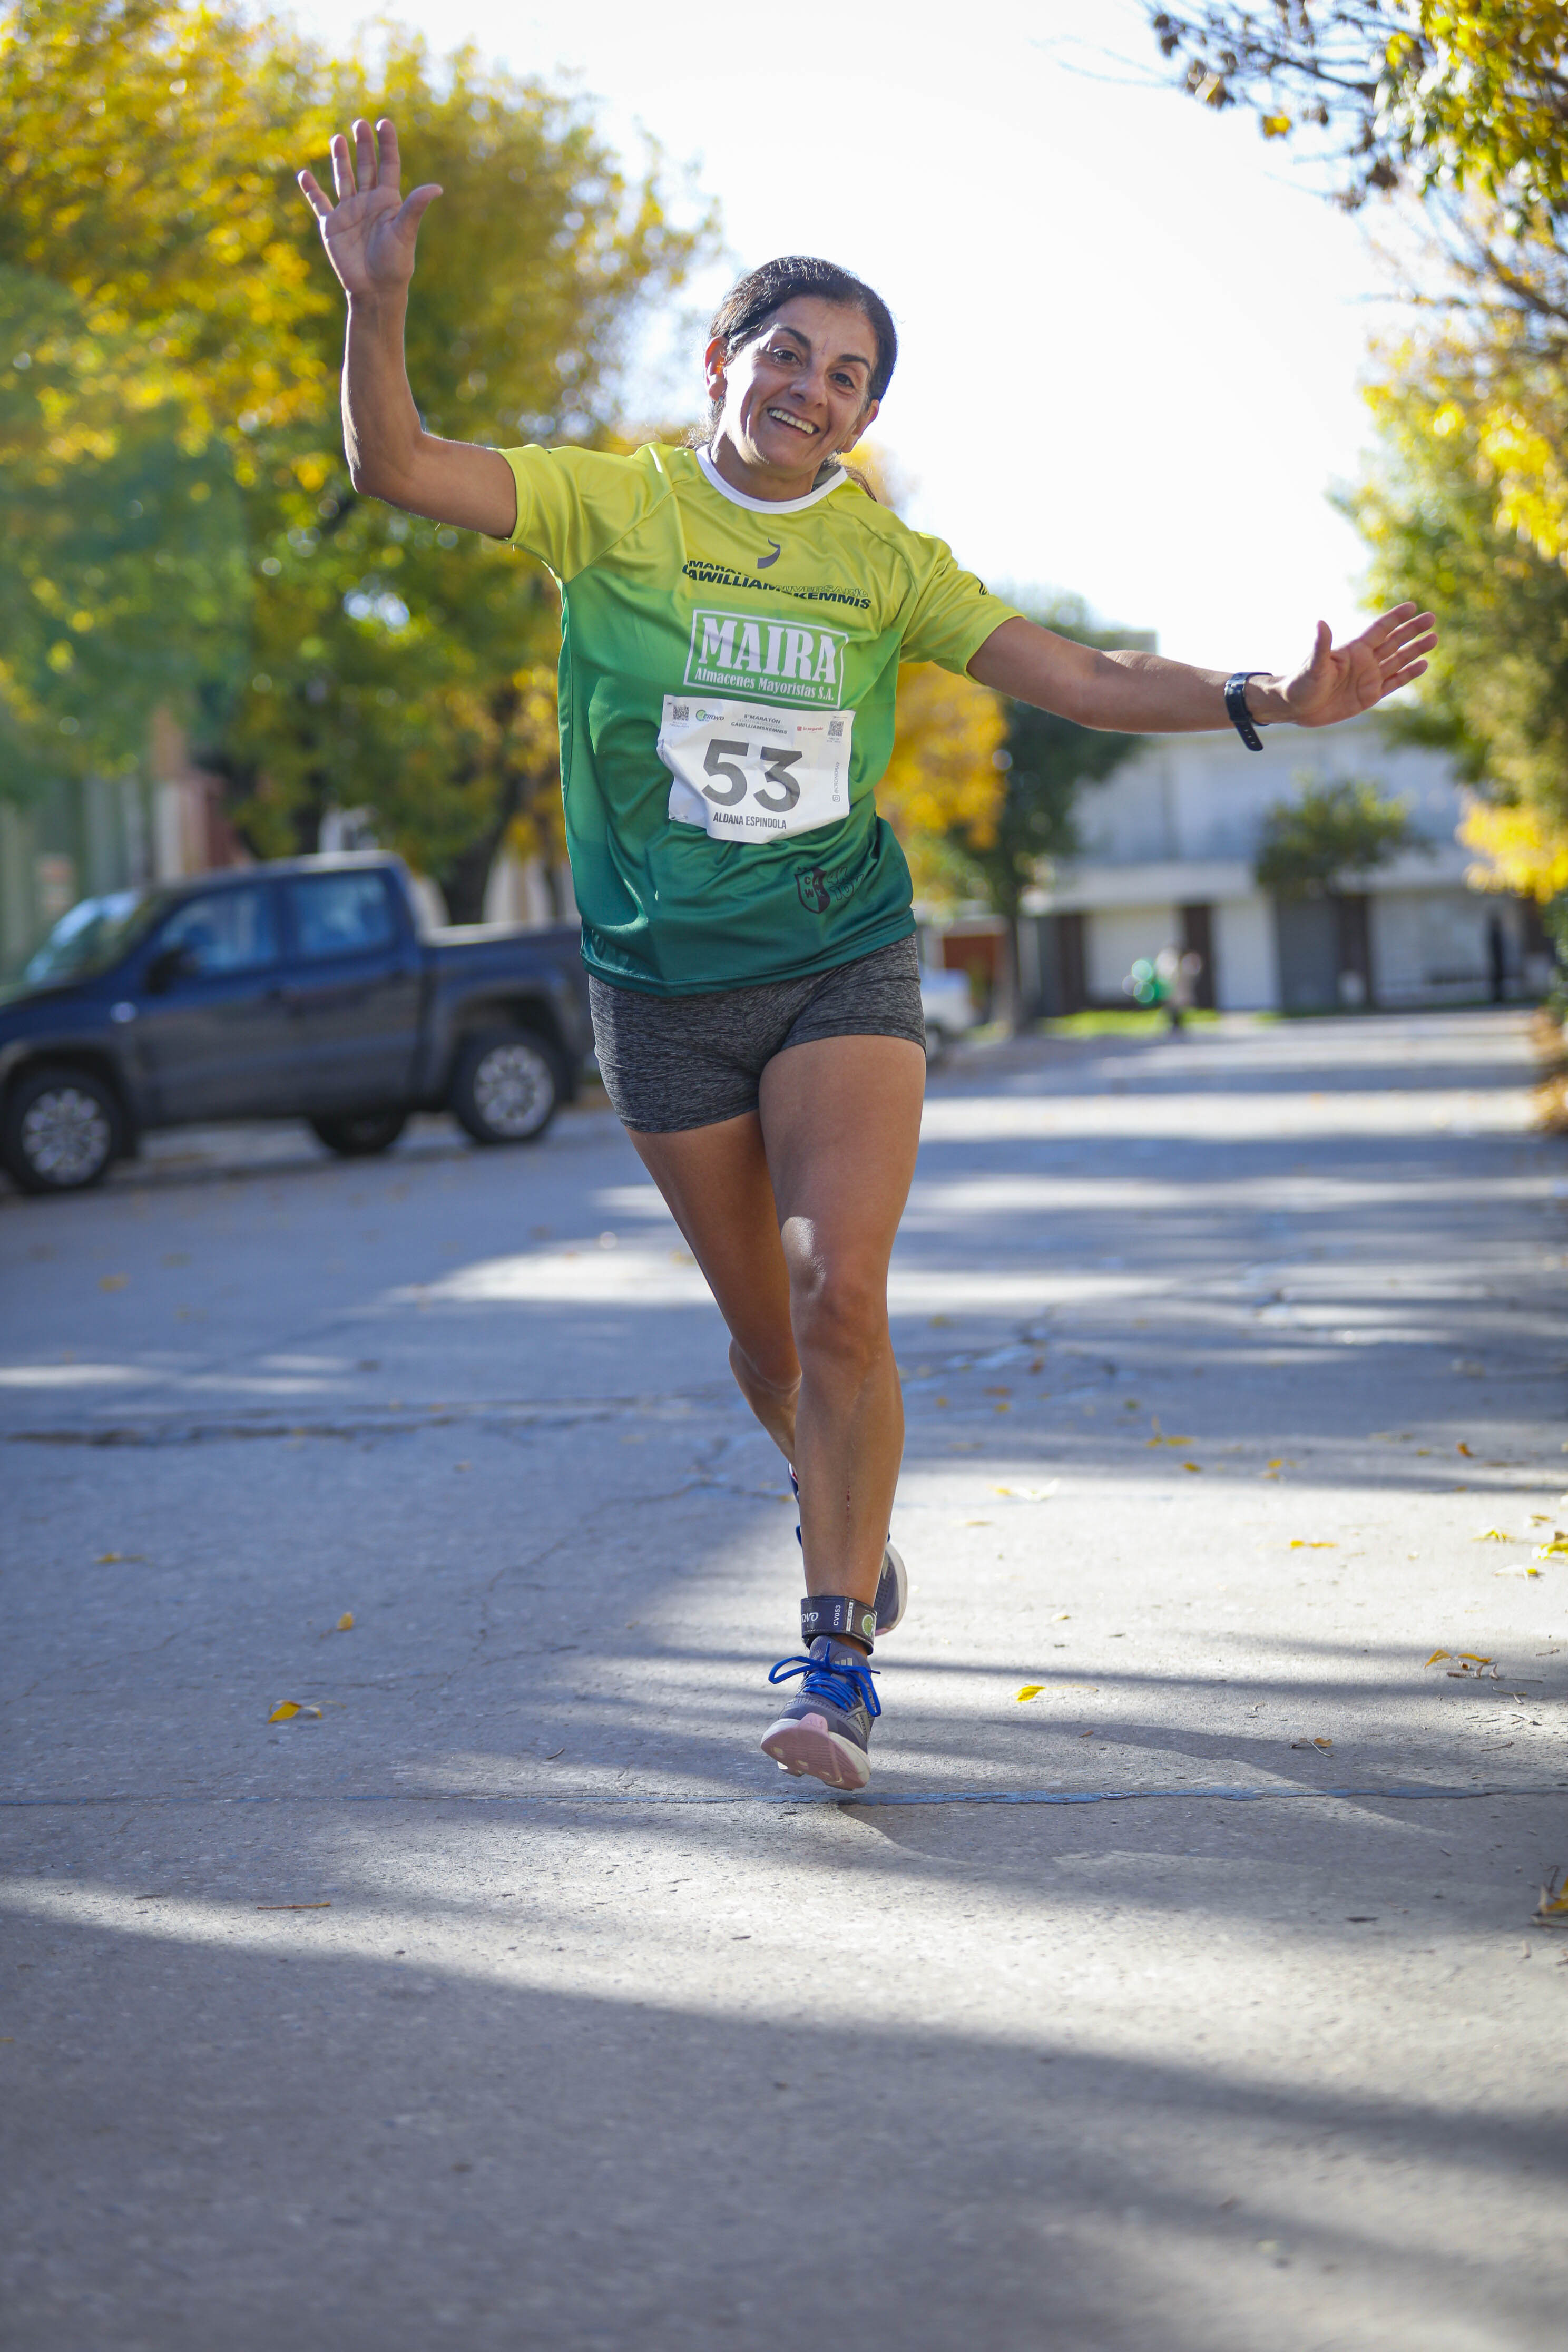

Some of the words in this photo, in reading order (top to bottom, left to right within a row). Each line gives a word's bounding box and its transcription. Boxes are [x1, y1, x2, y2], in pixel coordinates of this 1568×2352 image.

[698, 617, 837, 684] MAIRA
[694, 667, 756, 689] Almacenes
[758, 678, 816, 699] Mayoristas
[818, 687, 834, 701] S.A.
[701, 739, 803, 812] 53
[713, 812, 744, 826] ALDANA
[746, 816, 787, 829] ESPINDOLA
[833, 1604, 841, 1626] CV053
